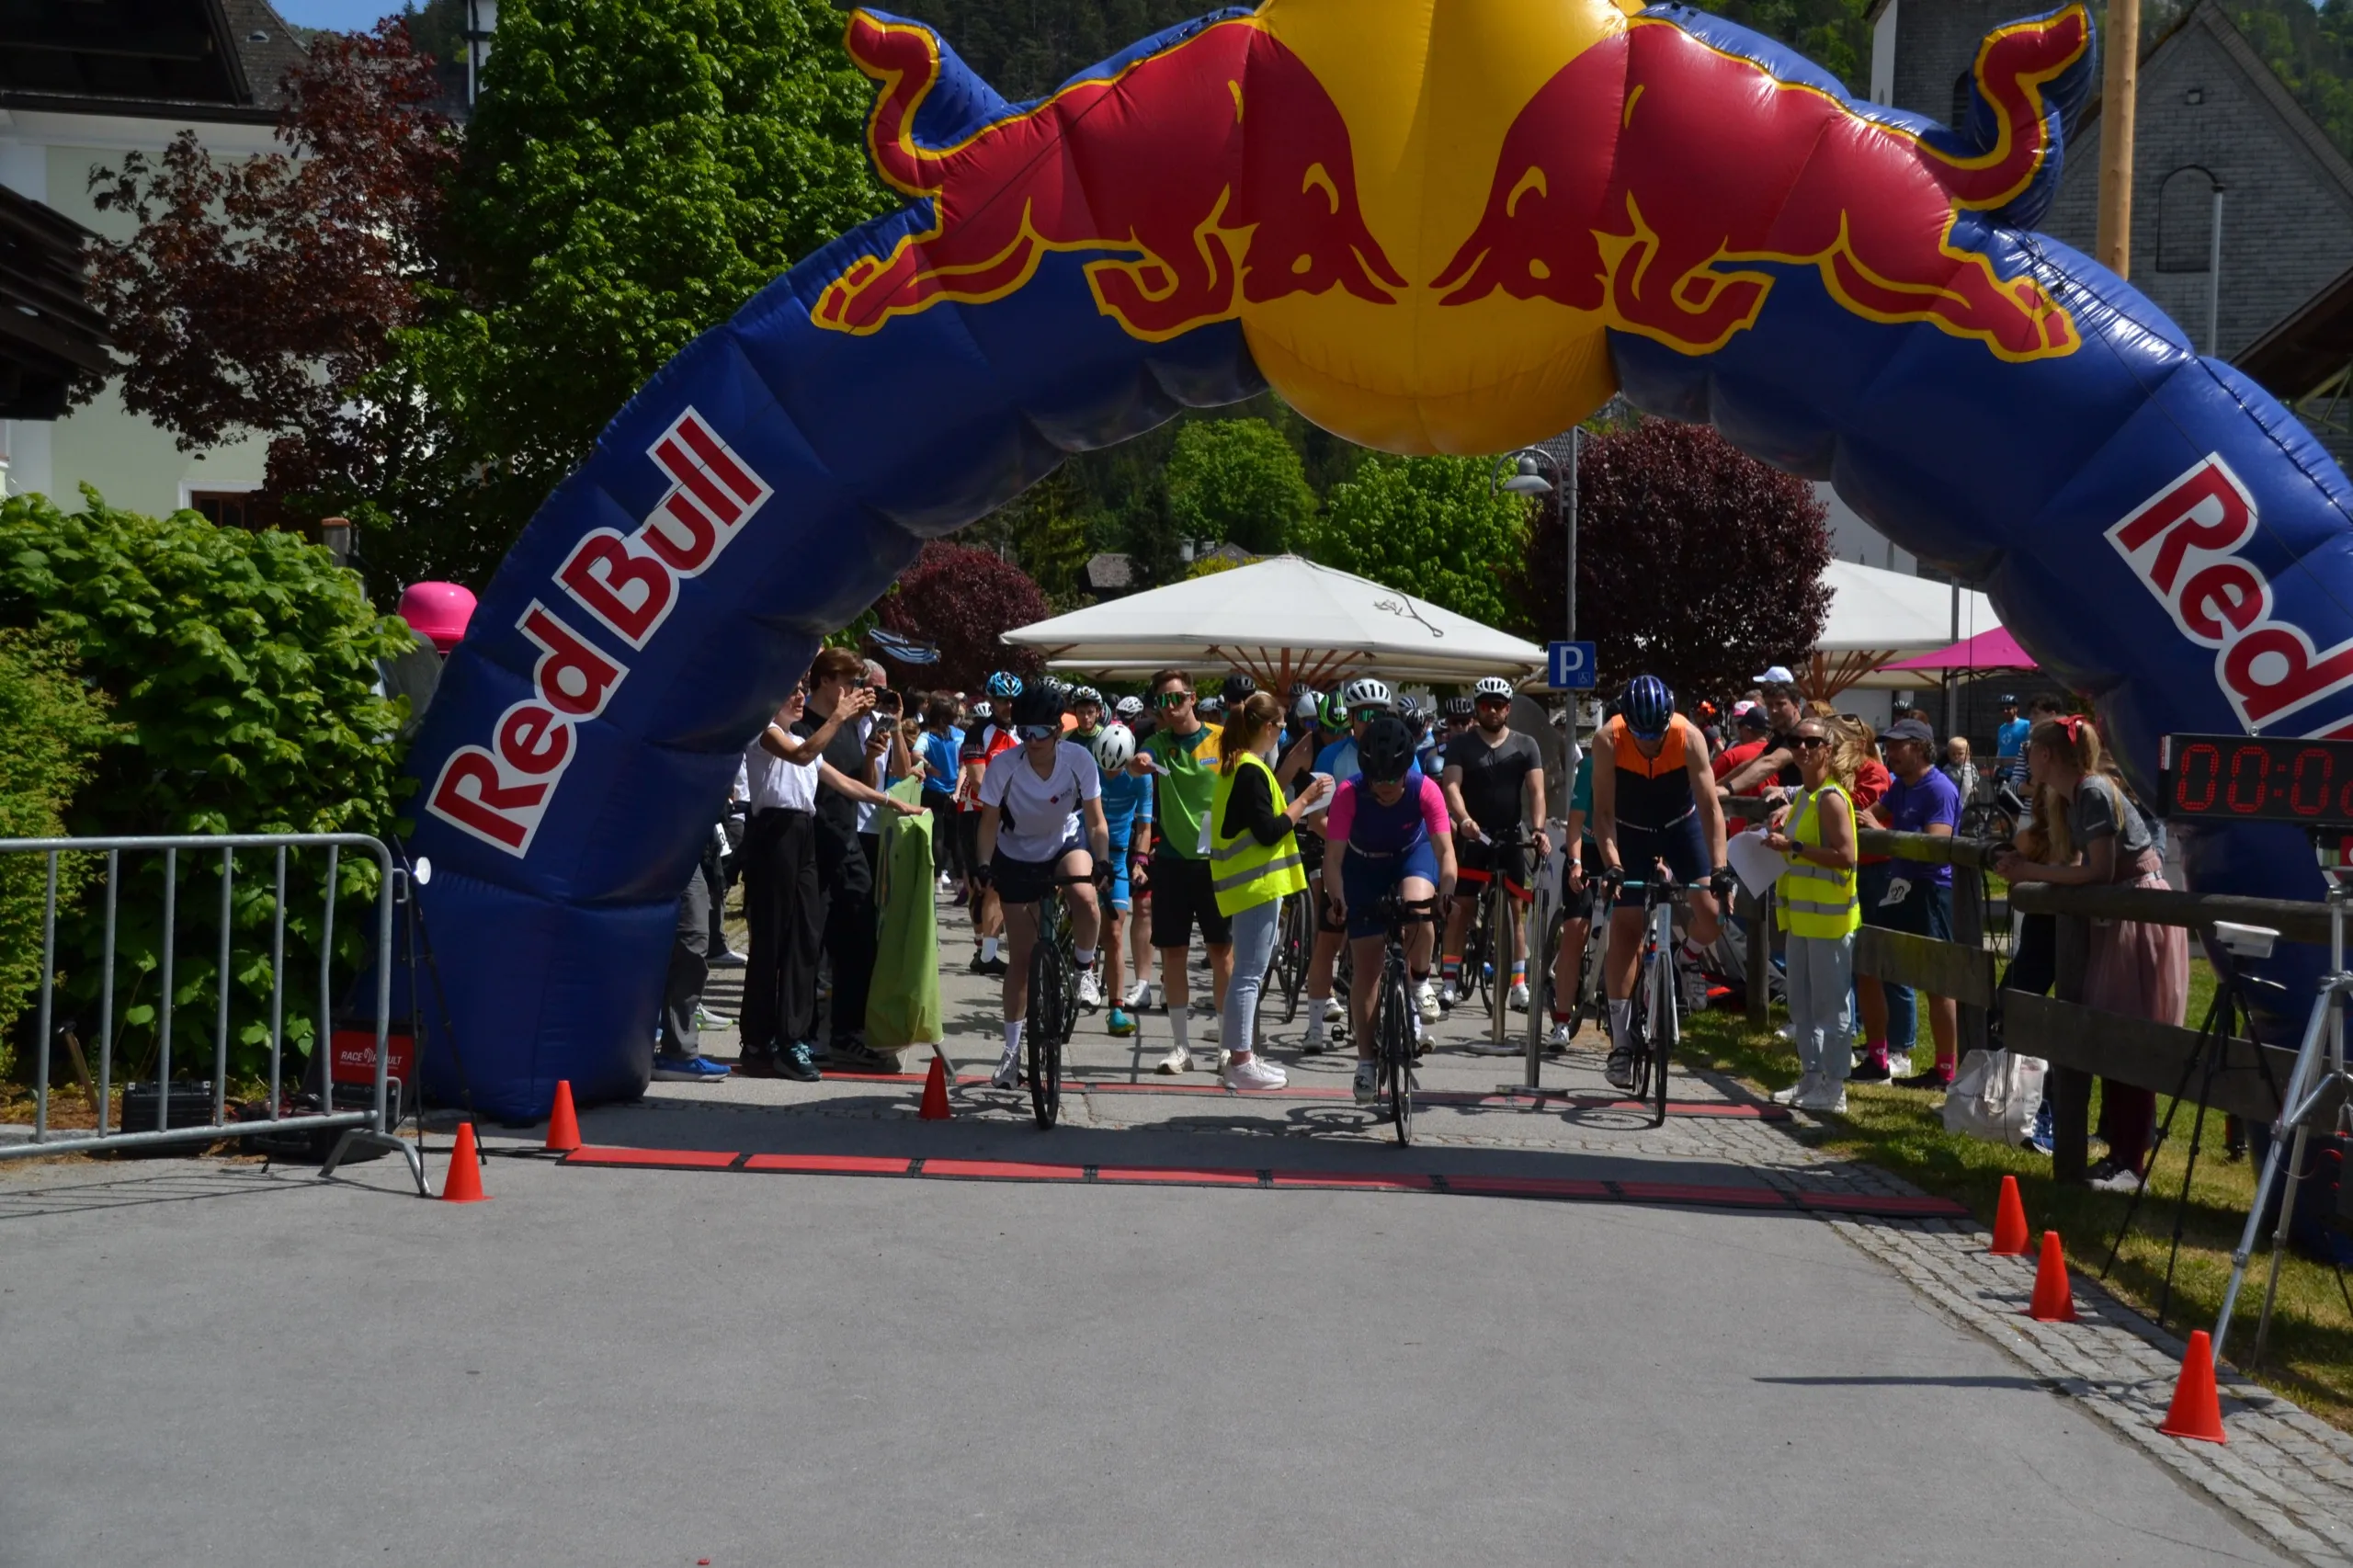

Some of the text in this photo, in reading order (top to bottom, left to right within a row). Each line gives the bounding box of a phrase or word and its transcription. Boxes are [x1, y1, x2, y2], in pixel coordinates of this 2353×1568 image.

[429, 409, 770, 855] Red Bull
[1559, 645, 1584, 684] P
[340, 1051, 364, 1062] RACE
[371, 1053, 403, 1066] RULT
